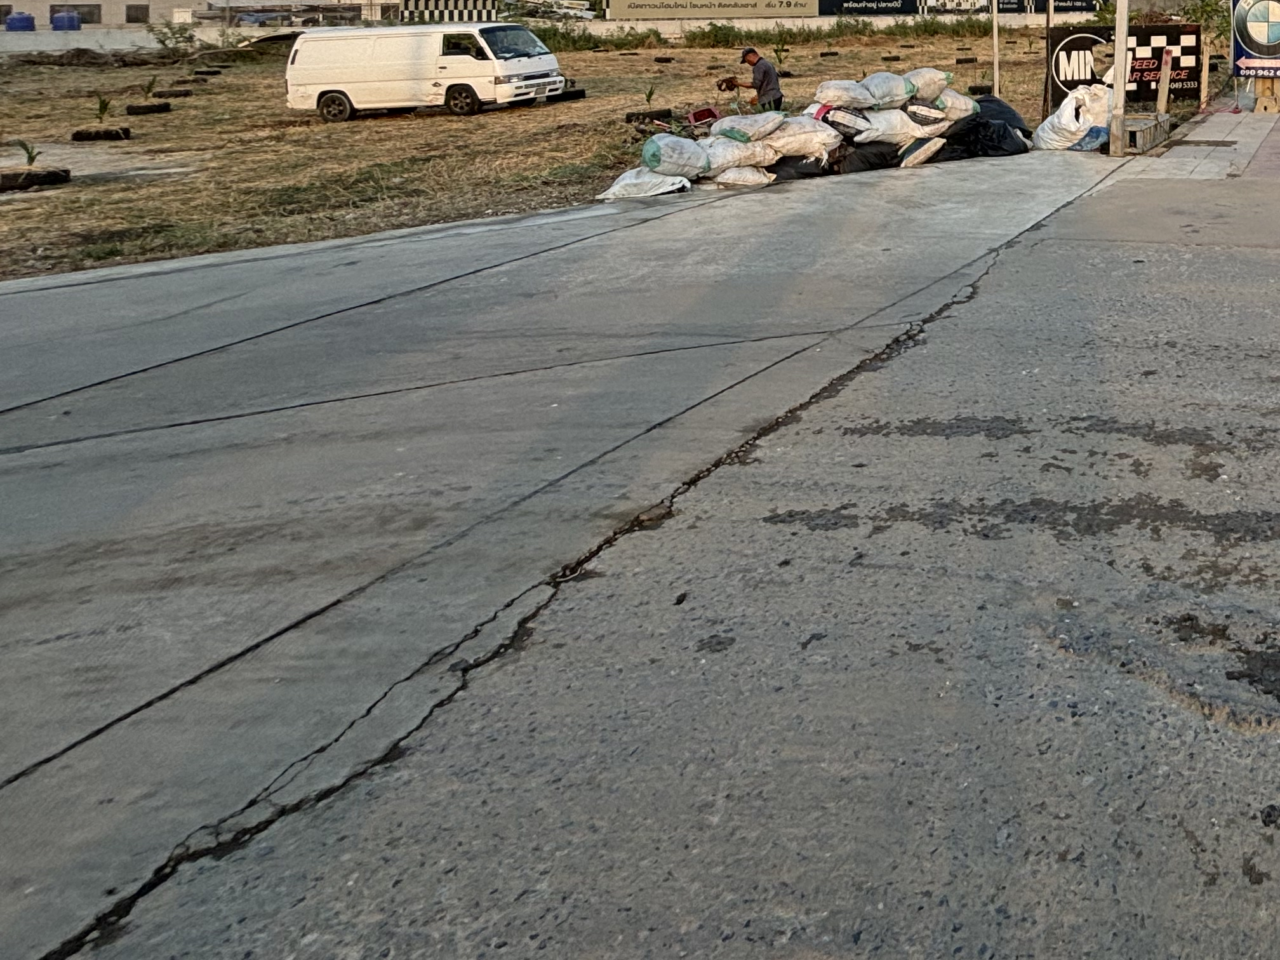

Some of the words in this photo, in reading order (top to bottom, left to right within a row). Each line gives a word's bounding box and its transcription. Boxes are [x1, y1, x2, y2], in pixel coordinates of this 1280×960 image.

[1059, 50, 1103, 82] MIN
[1131, 59, 1158, 69] PEED
[1128, 71, 1141, 81] AR
